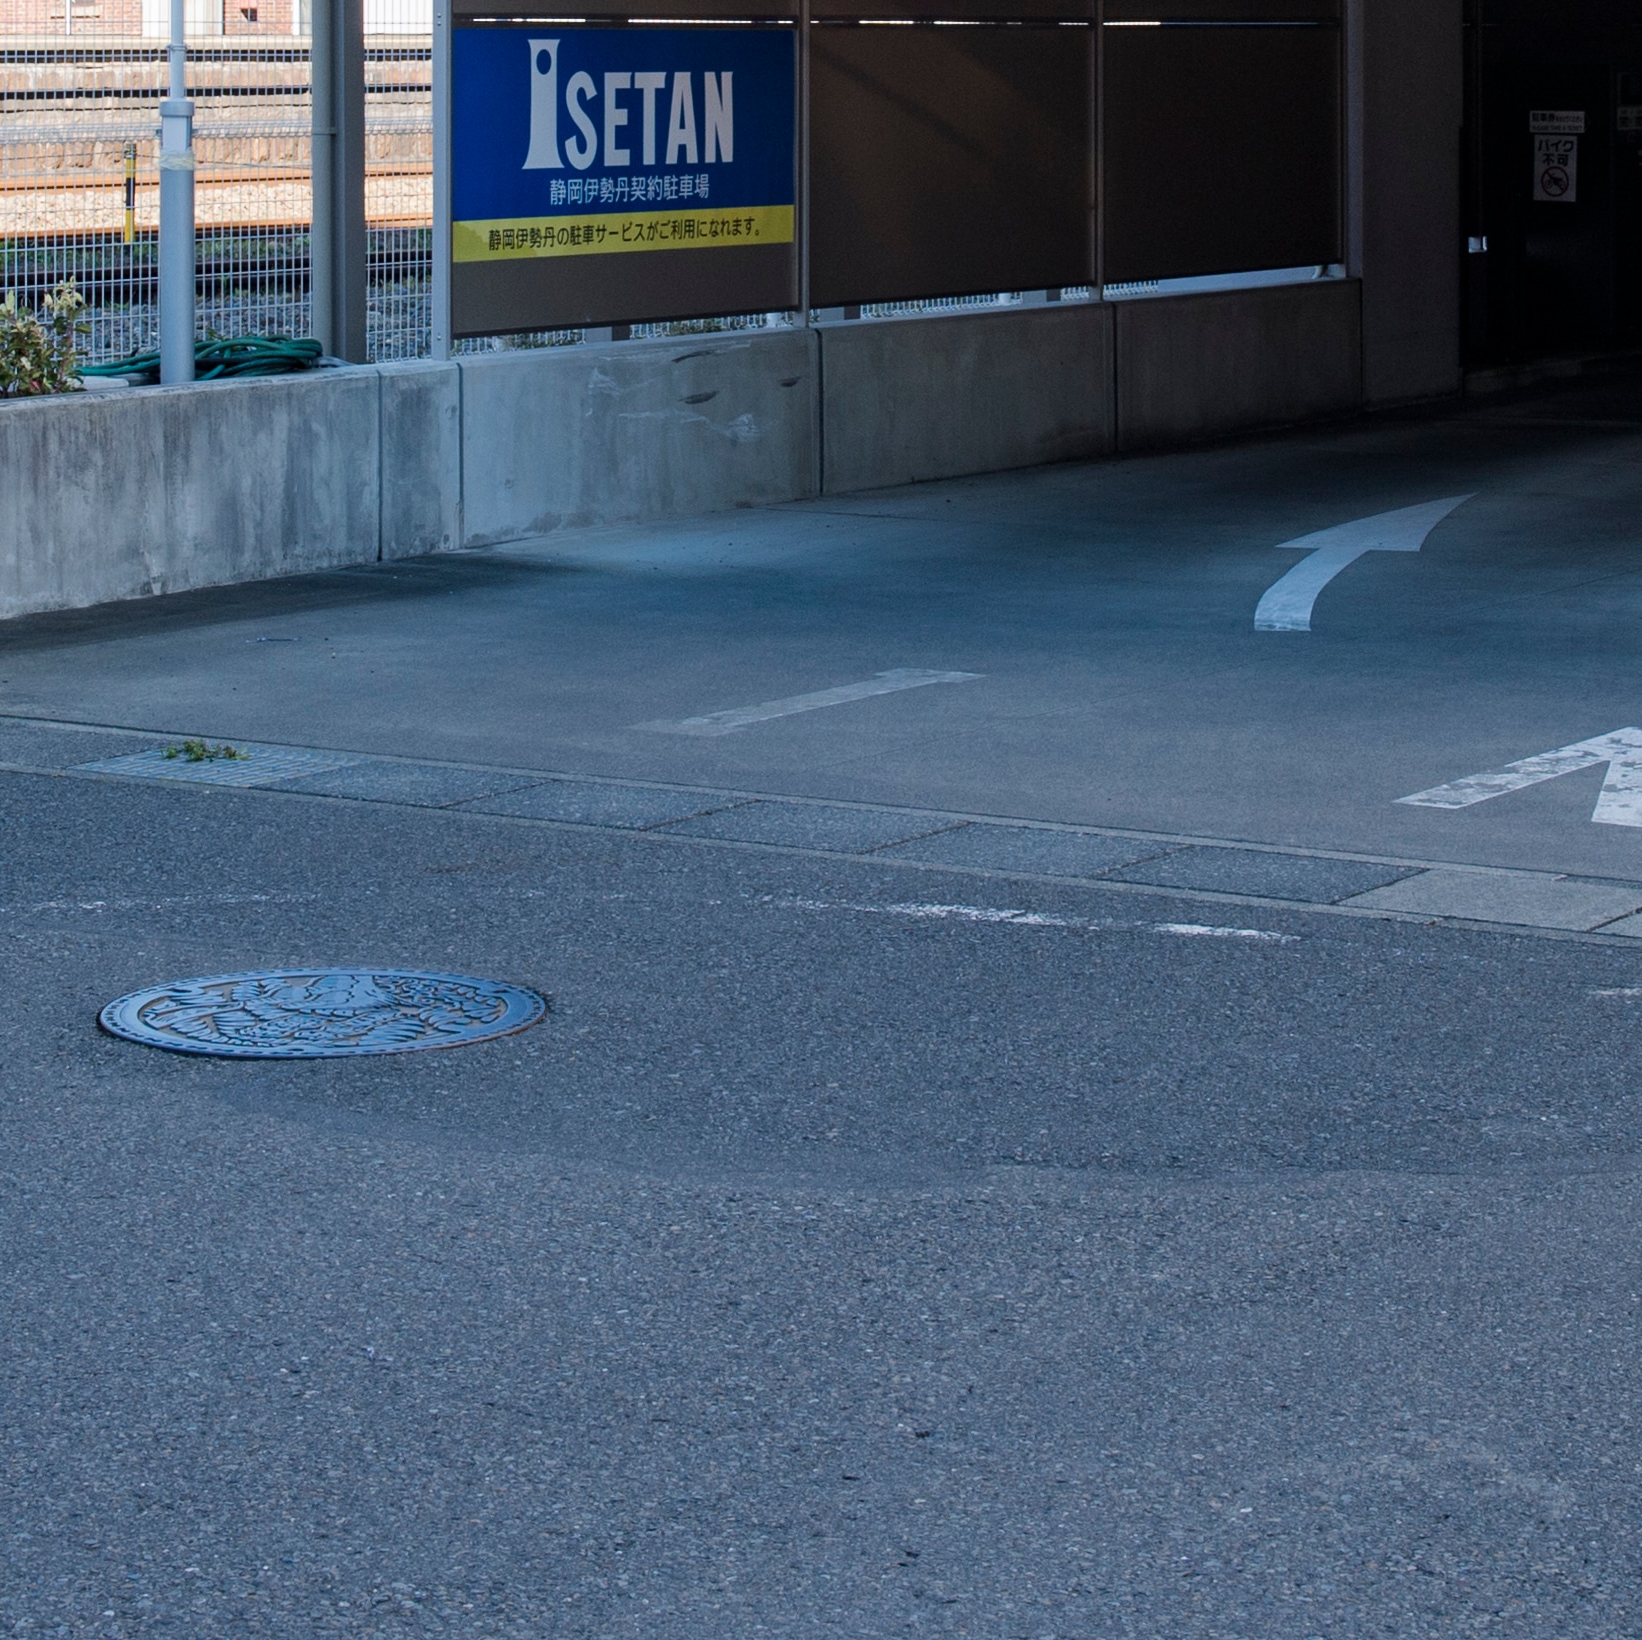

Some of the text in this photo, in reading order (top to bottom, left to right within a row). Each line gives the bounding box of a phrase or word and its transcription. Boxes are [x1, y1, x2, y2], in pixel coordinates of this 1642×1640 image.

[521, 38, 734, 171] ISETAN
[1538, 139, 1574, 152] バイク
[1542, 153, 1568, 166] 不可
[549, 173, 710, 206] 静岡伊勢丹契約駐車場
